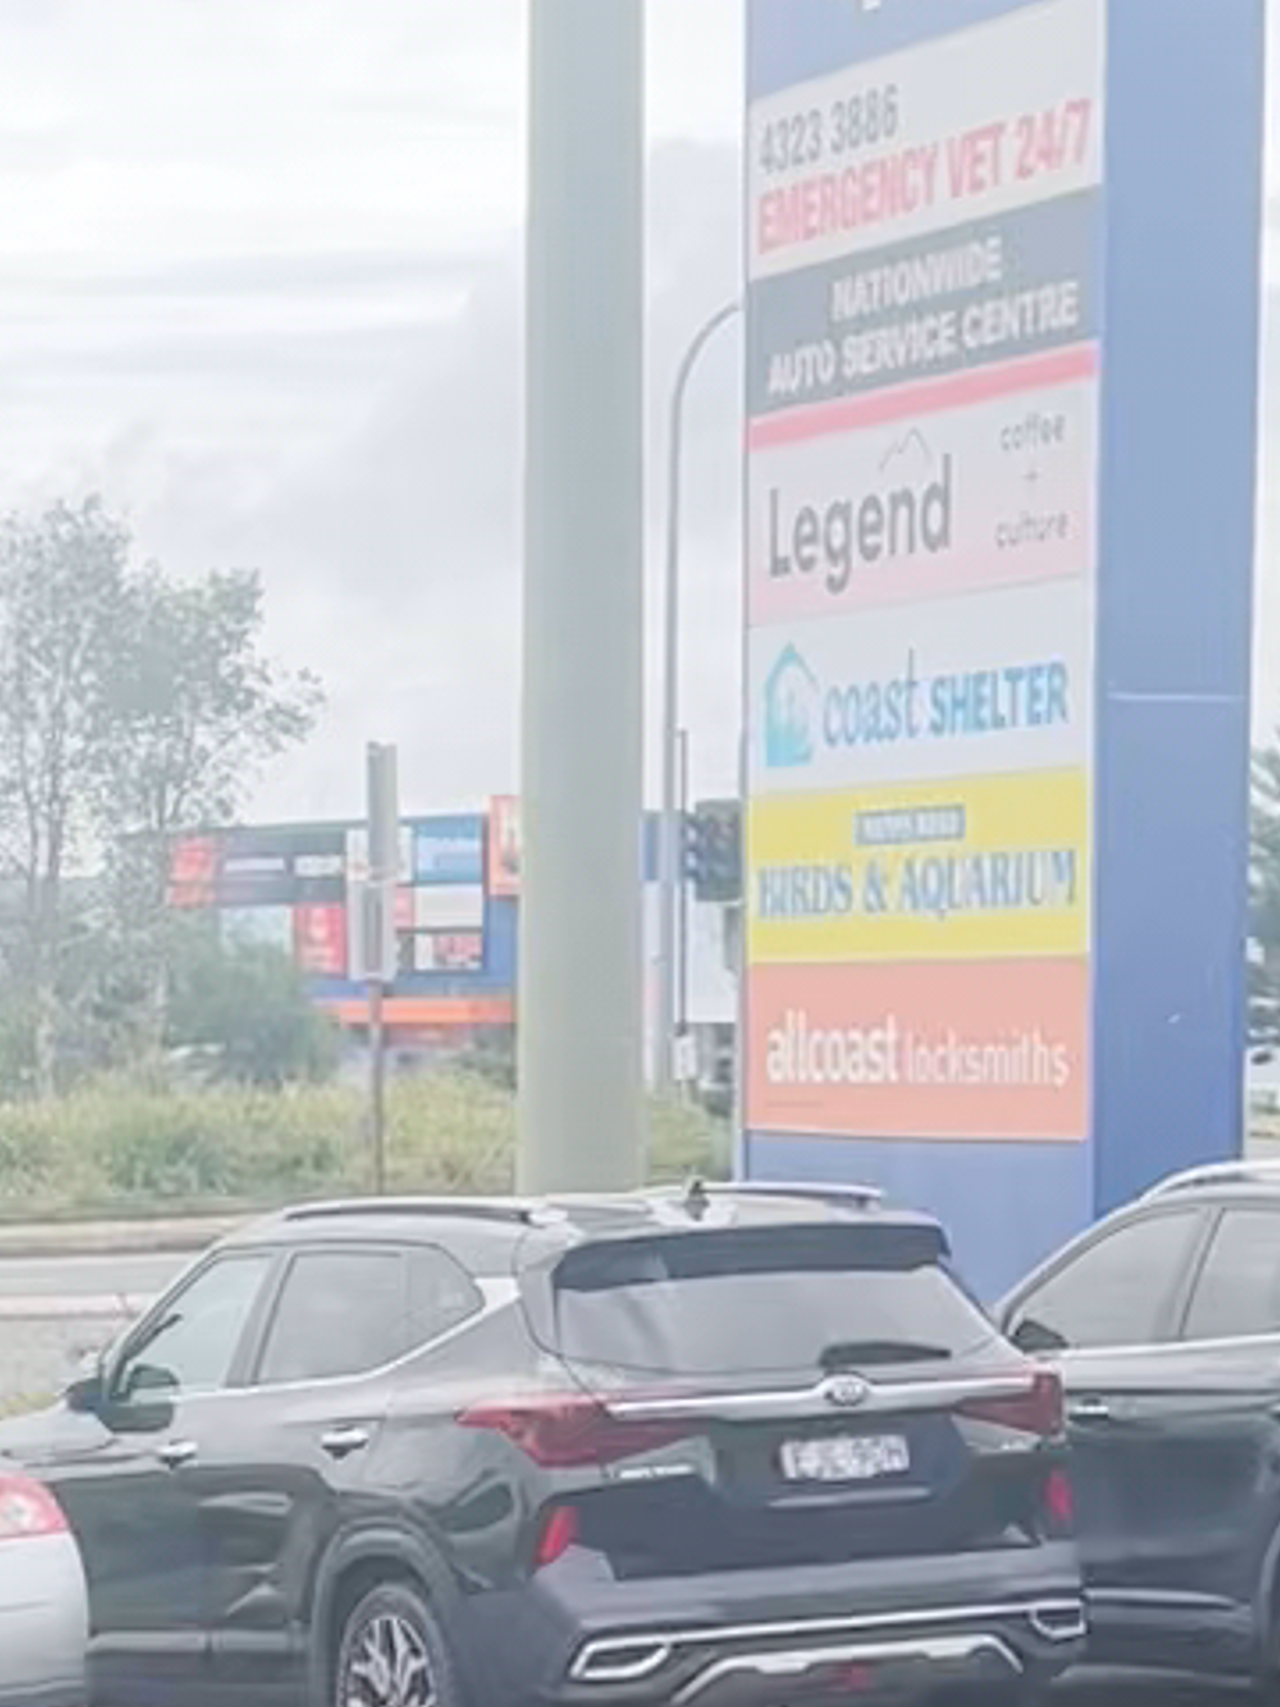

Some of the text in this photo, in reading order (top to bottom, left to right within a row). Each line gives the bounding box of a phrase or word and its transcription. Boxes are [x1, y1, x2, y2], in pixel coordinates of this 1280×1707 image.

[757, 97, 1094, 256] EMERGENCY VET 24/7
[759, 109, 821, 174] 4323
[831, 236, 1003, 322] NATIONWIDE
[768, 281, 1079, 395] AUTO SERVICE CENTRE
[1000, 412, 1066, 451] coffee
[769, 451, 953, 595] Legend
[994, 510, 1069, 550] culture
[822, 647, 1070, 748] coast SHELTER
[757, 864, 854, 920] BIRDS
[899, 847, 1077, 921] AQUARIUM
[766, 1008, 1072, 1089] allcoast locksmiths
